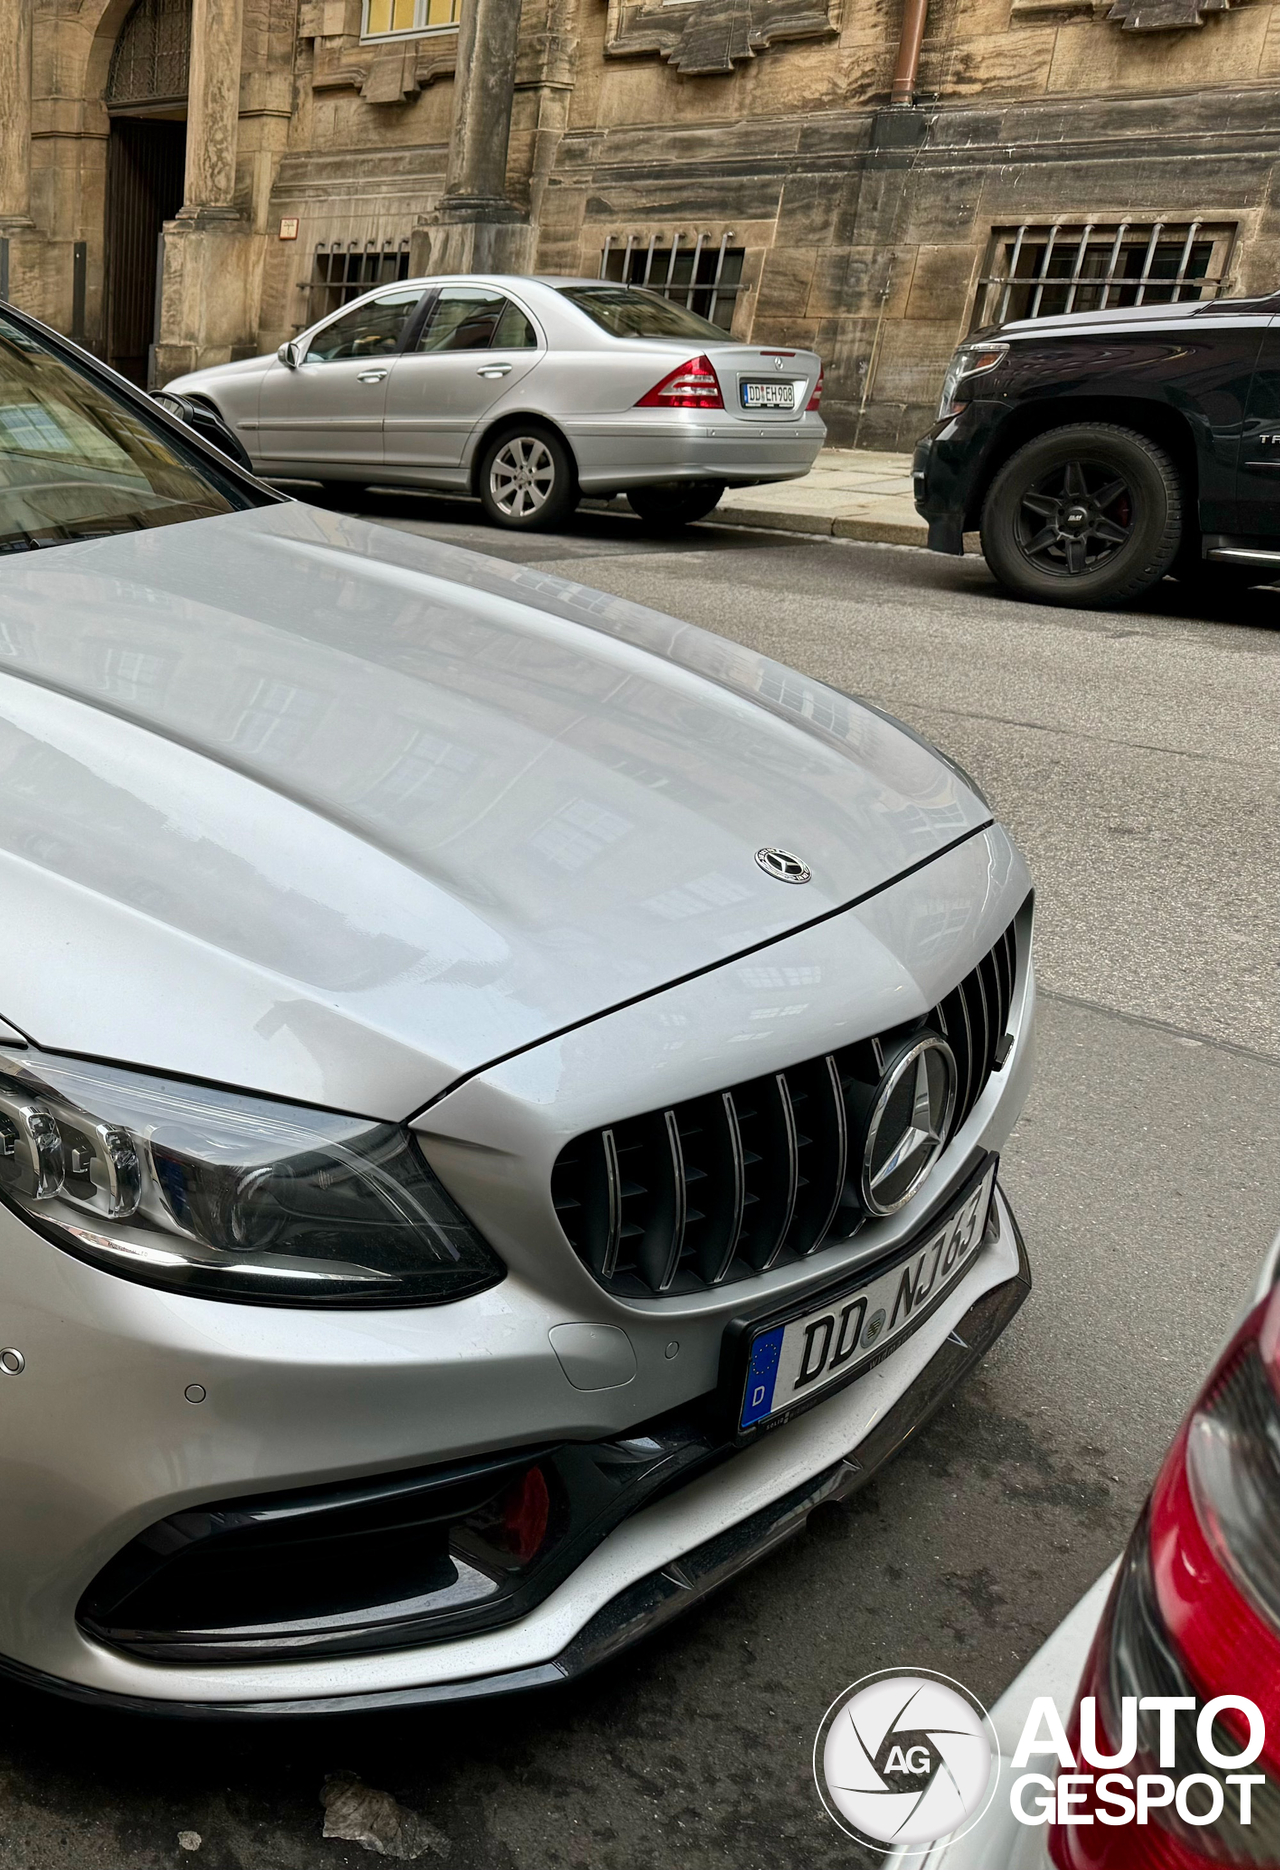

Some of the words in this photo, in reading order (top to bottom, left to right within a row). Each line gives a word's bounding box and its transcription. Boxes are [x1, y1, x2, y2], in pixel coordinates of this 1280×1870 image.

[749, 386, 761, 401] DD
[793, 1295, 869, 1391] DD
[751, 1385, 766, 1407] D
